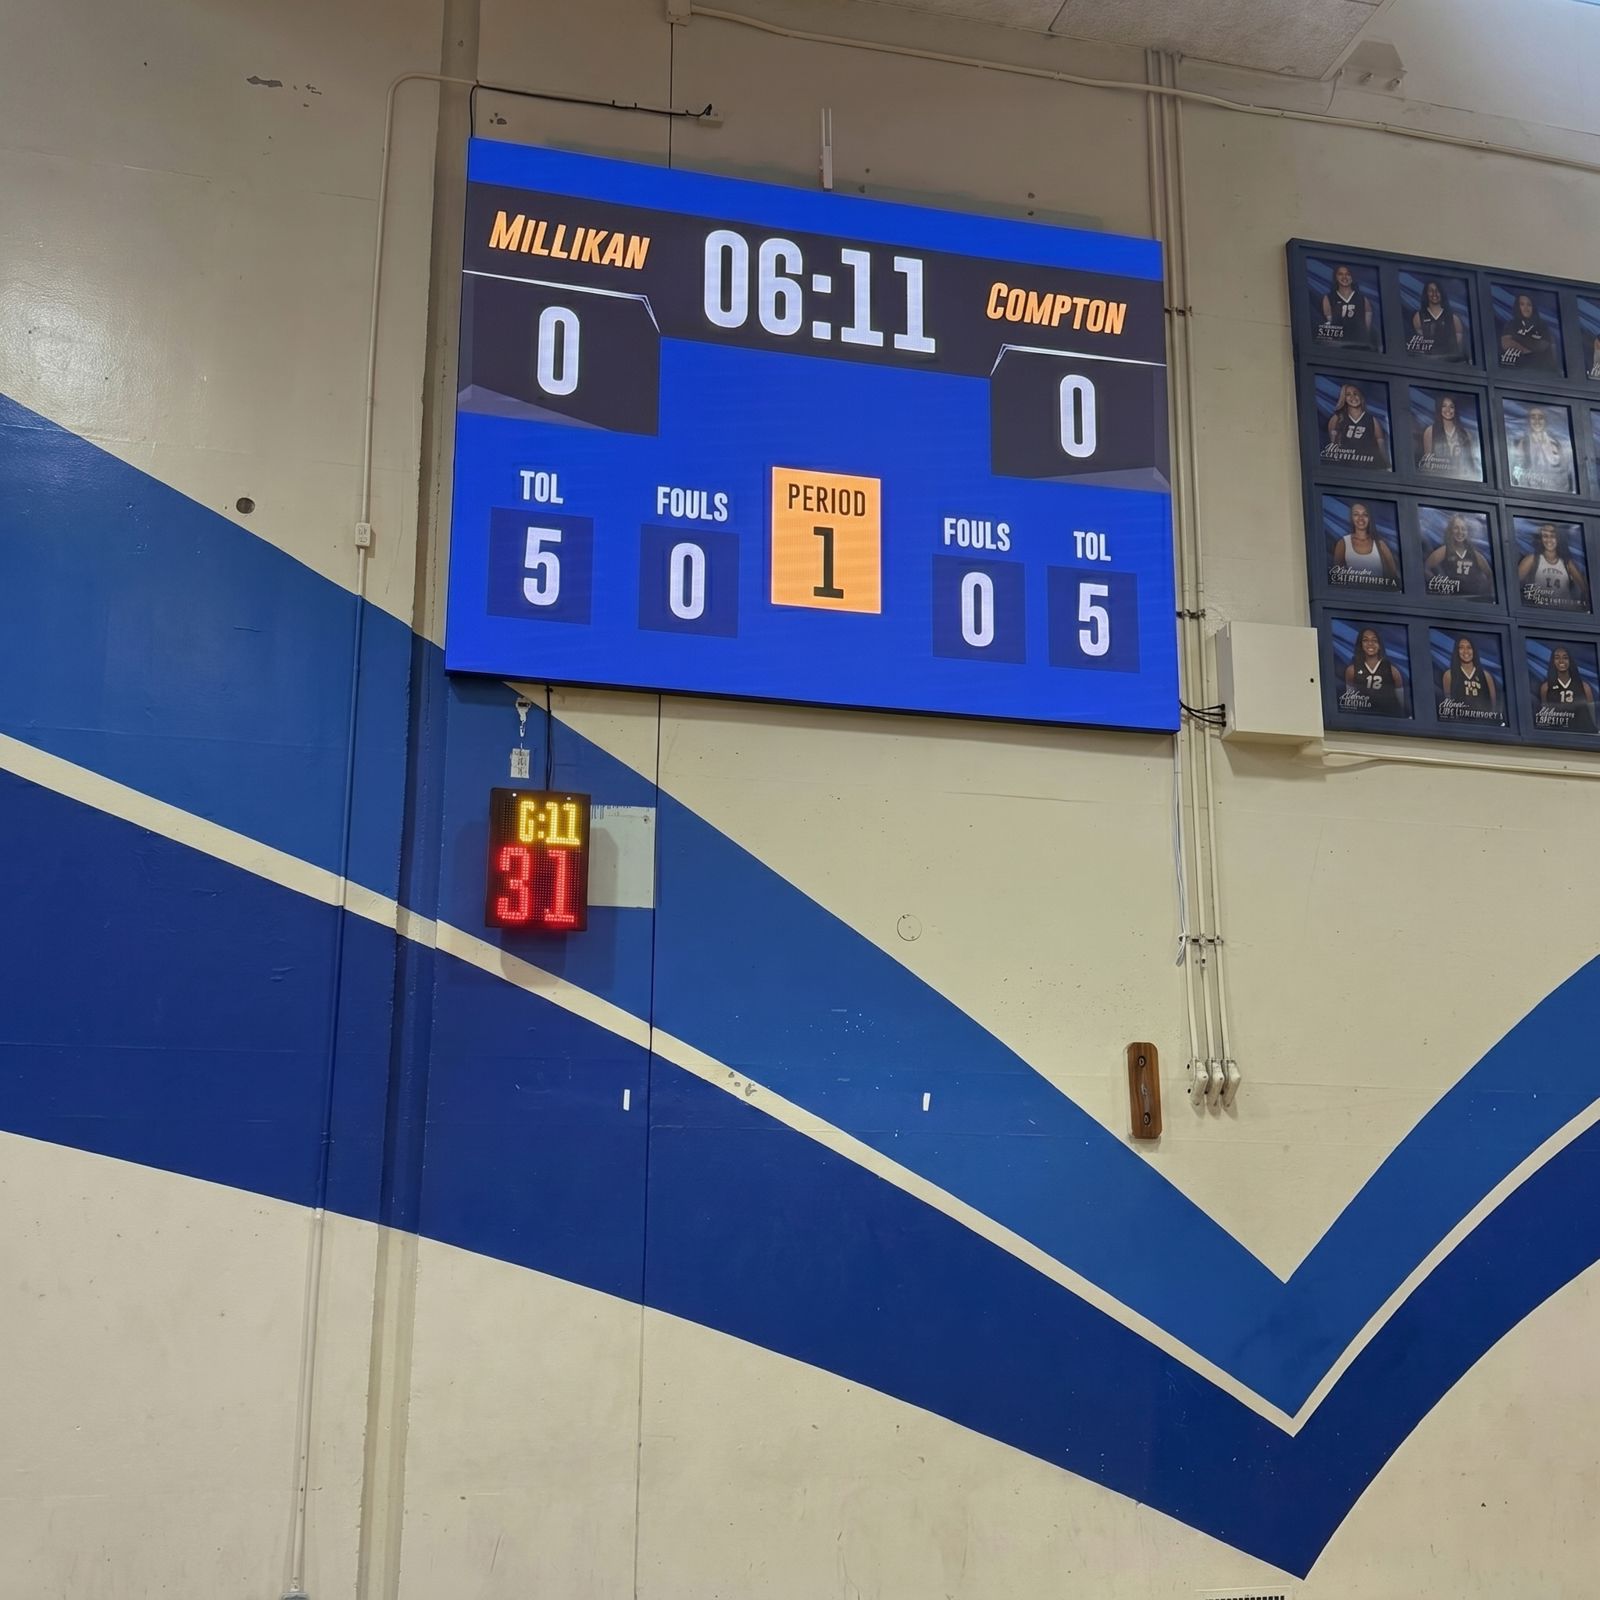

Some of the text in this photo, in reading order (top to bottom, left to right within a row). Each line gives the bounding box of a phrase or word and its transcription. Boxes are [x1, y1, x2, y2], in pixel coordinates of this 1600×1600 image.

[488, 210, 651, 271] MILLIKAN
[703, 229, 937, 354] 06:11
[986, 282, 1127, 335] COMPTON
[536, 306, 580, 396] 0
[1059, 374, 1097, 458] 0
[520, 470, 564, 504] TOL
[657, 486, 728, 522] FOULS
[788, 483, 866, 517] PERIOD
[523, 526, 562, 606] 5
[813, 526, 844, 599] 1
[944, 517, 1011, 552] FOULS
[1073, 531, 1112, 562] TOL
[669, 542, 706, 620] 0
[961, 571, 994, 647] 0
[1078, 582, 1110, 656] 5
[519, 800, 581, 845] 6:11
[497, 846, 576, 923] 31
